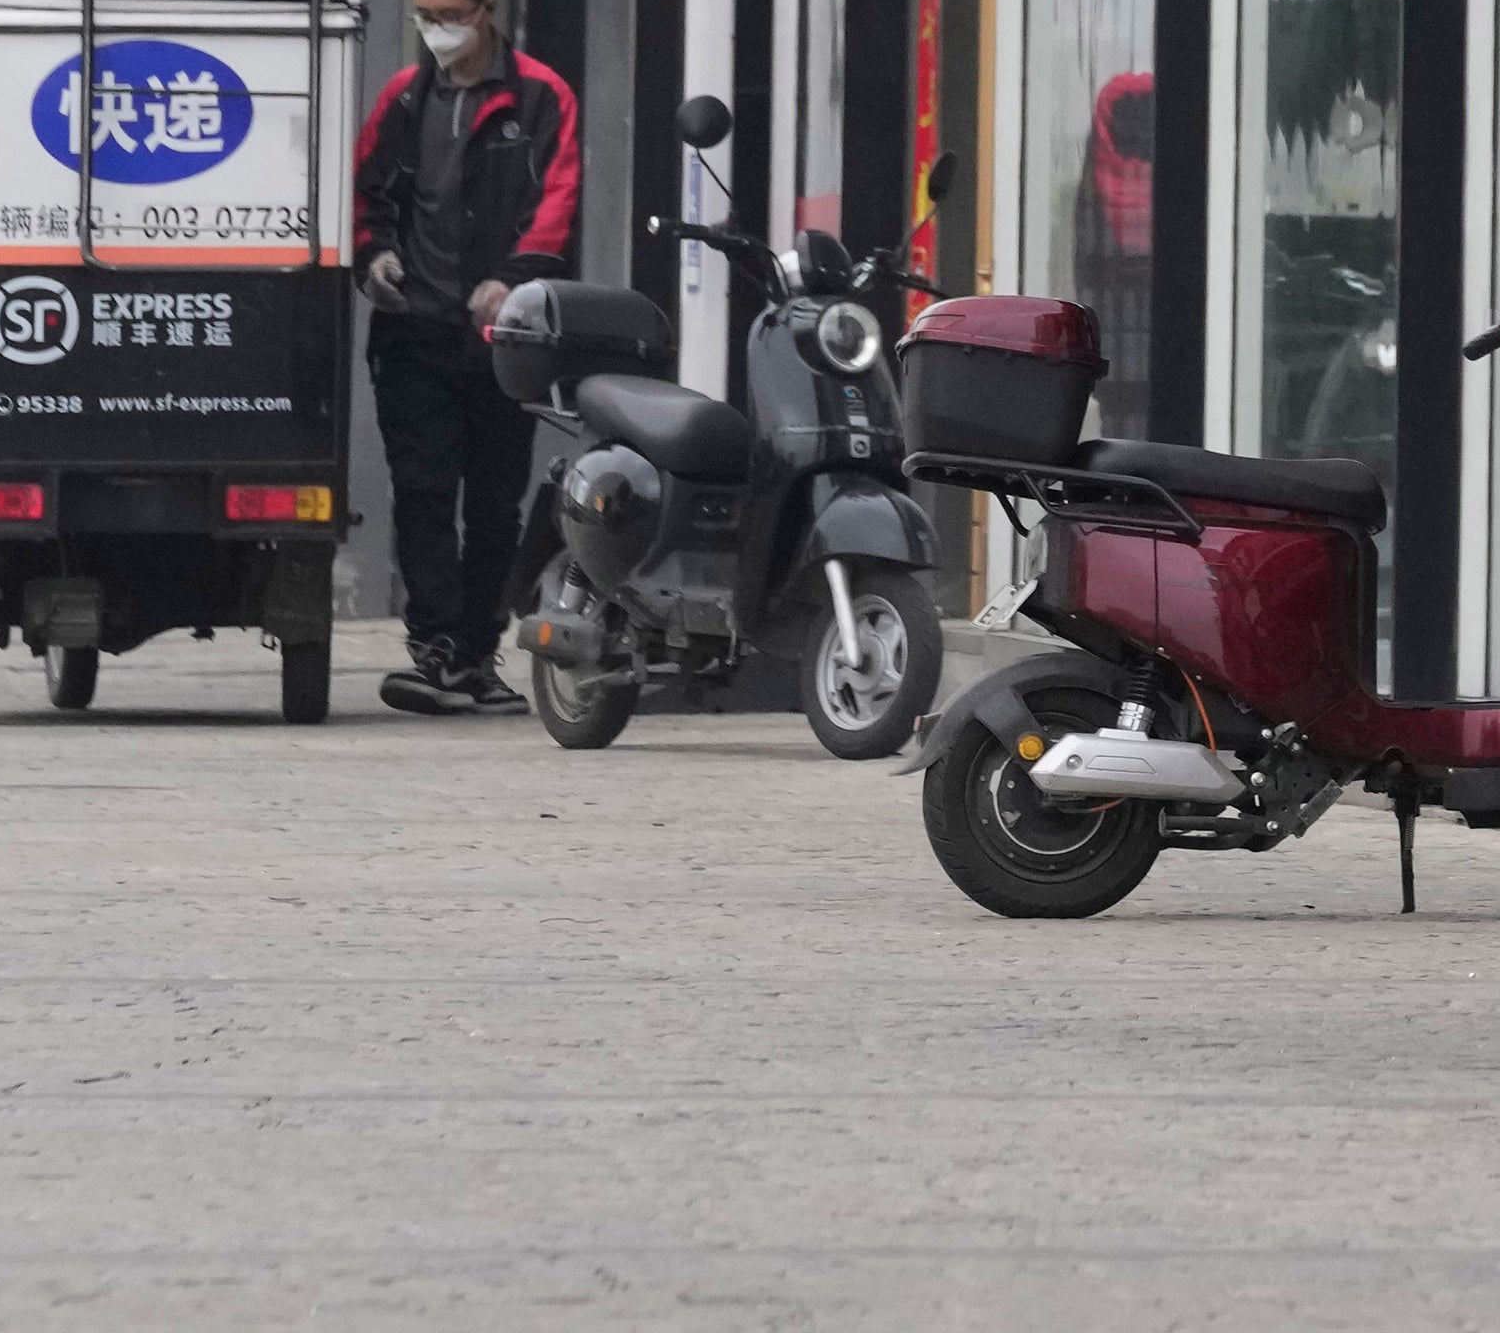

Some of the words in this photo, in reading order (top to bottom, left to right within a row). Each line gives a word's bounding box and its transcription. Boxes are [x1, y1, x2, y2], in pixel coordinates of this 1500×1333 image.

[59, 70, 225, 155] 快递
[142, 205, 199, 240] 003
[4, 298, 62, 343] SF
[92, 293, 233, 321] EXPRESS
[17, 394, 83, 414] 95338
[99, 393, 293, 416] www.sf-express.com
